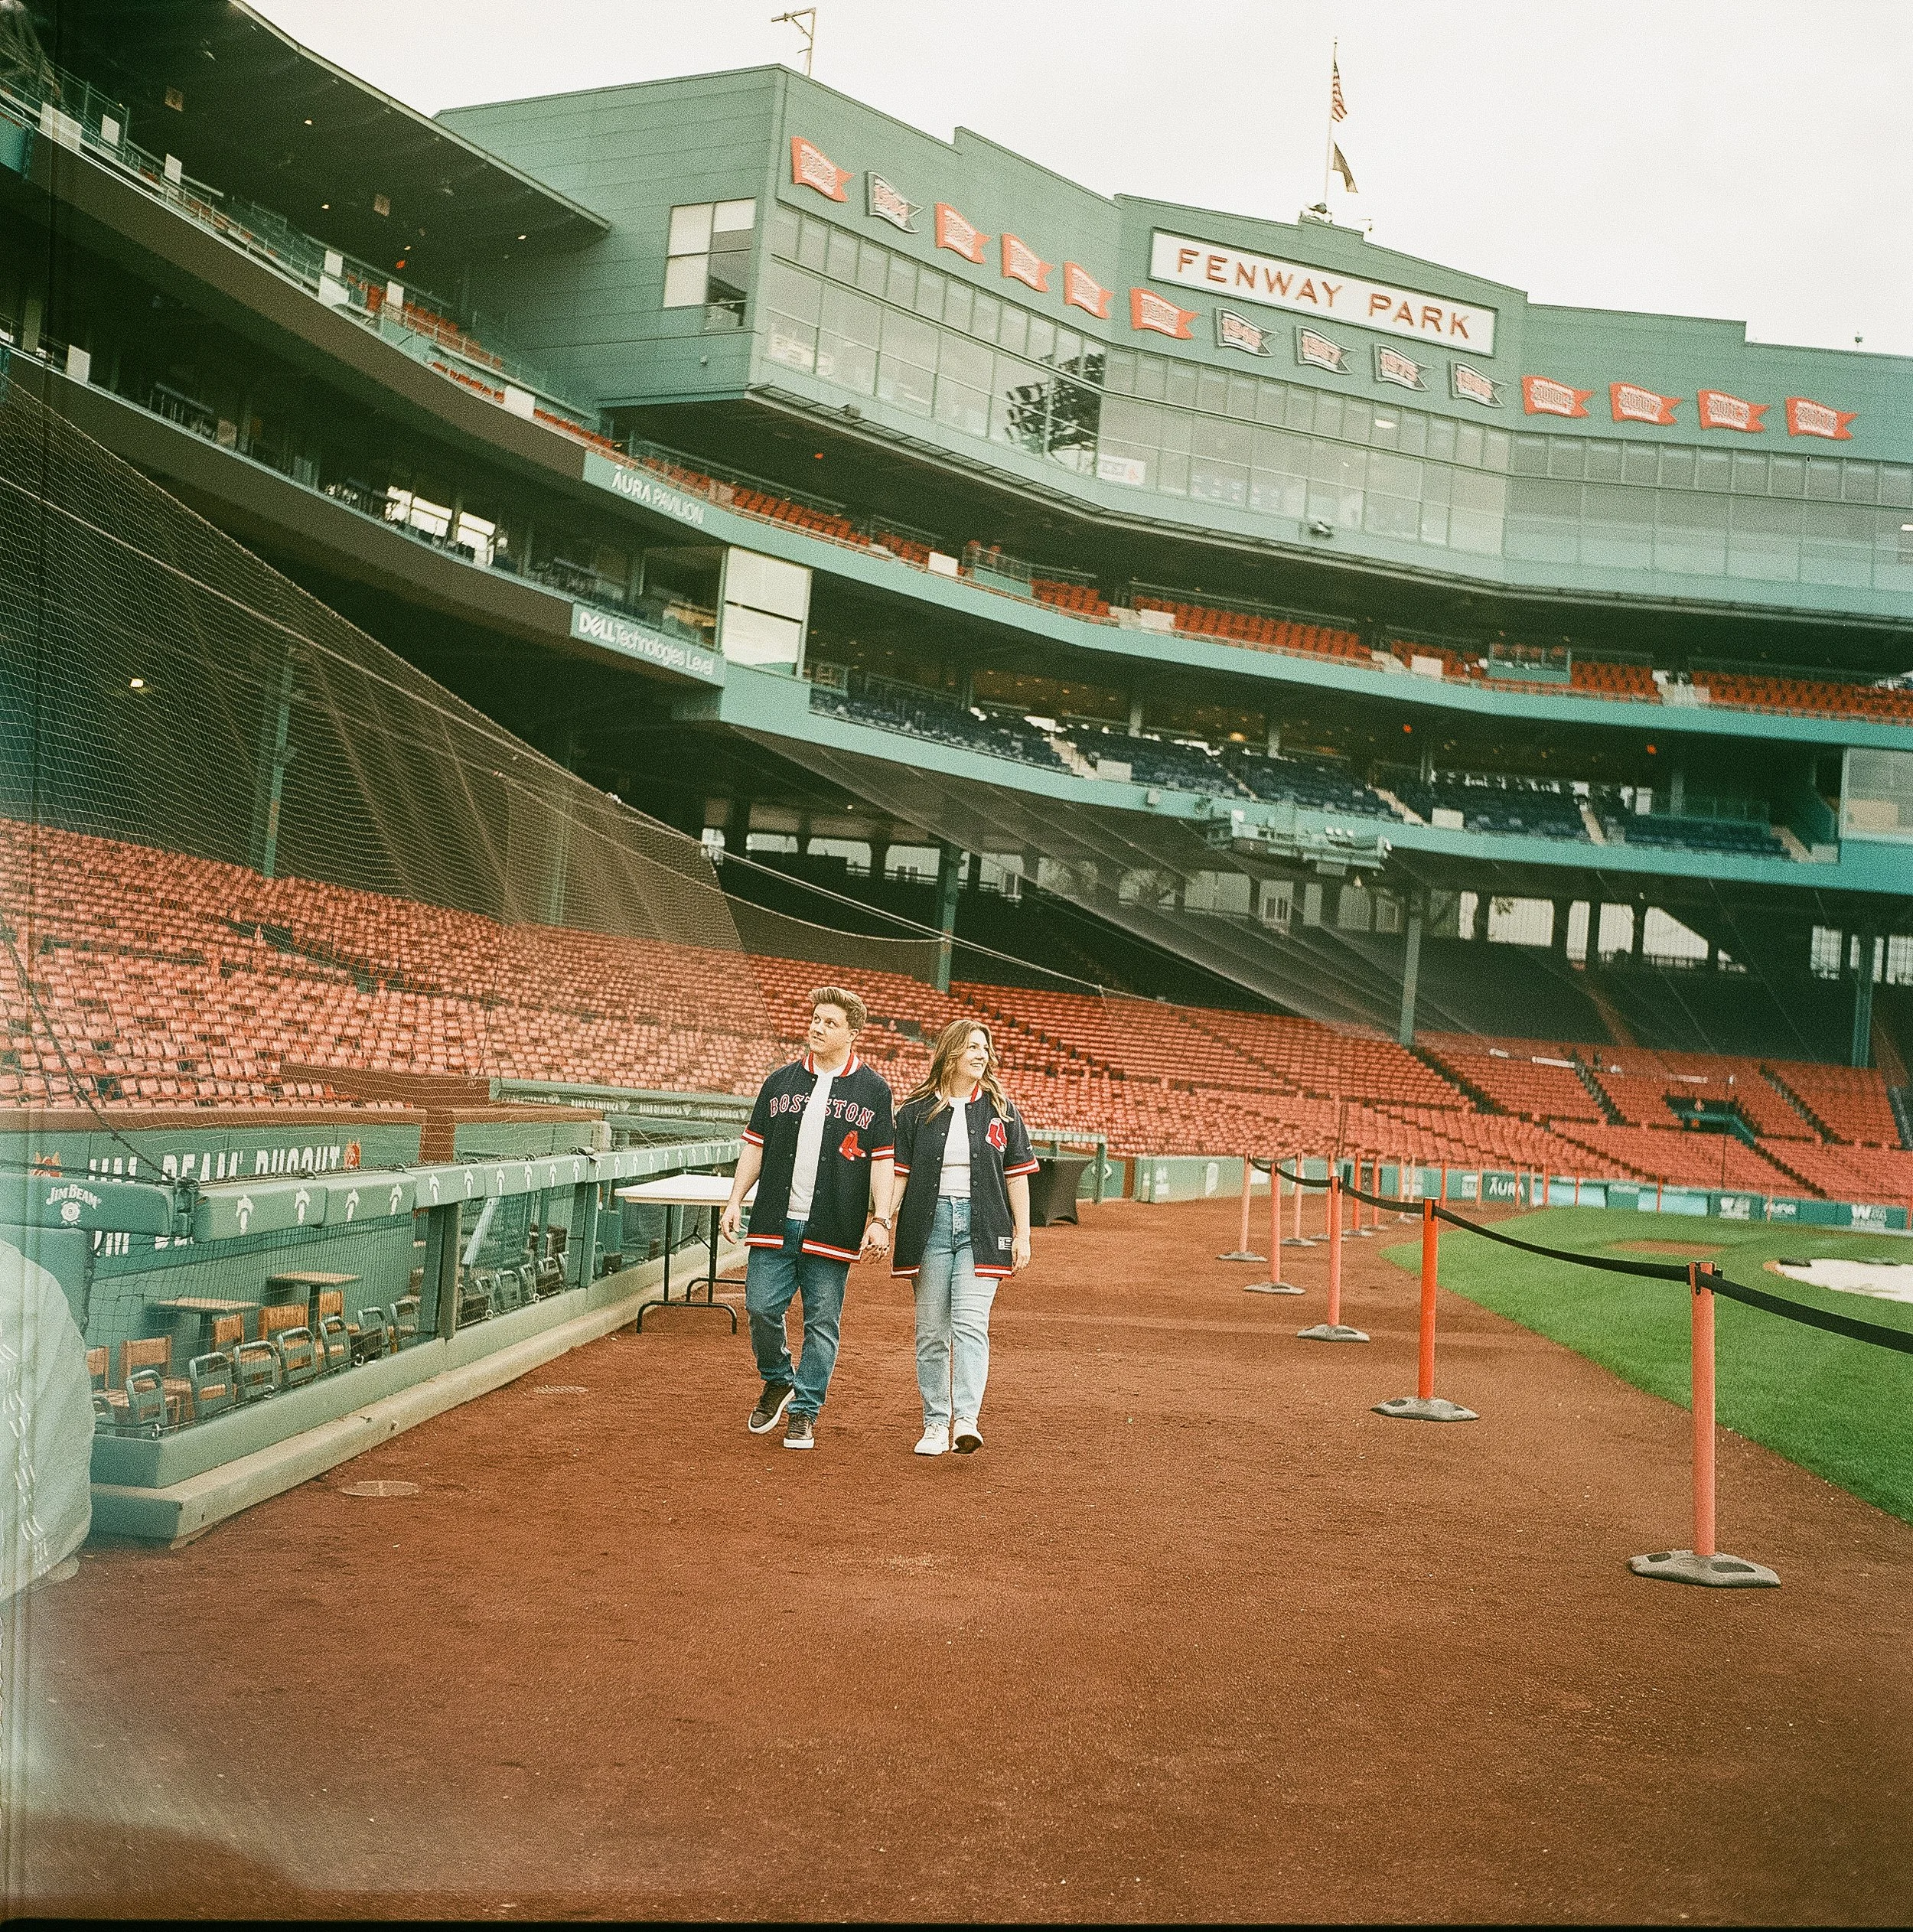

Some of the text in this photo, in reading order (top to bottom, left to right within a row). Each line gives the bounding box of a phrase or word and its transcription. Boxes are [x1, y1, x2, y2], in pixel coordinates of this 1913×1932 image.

[1178, 247, 1473, 340] FENWAY PARK
[578, 611, 615, 643] DELL
[46, 1187, 68, 1206] JIM
